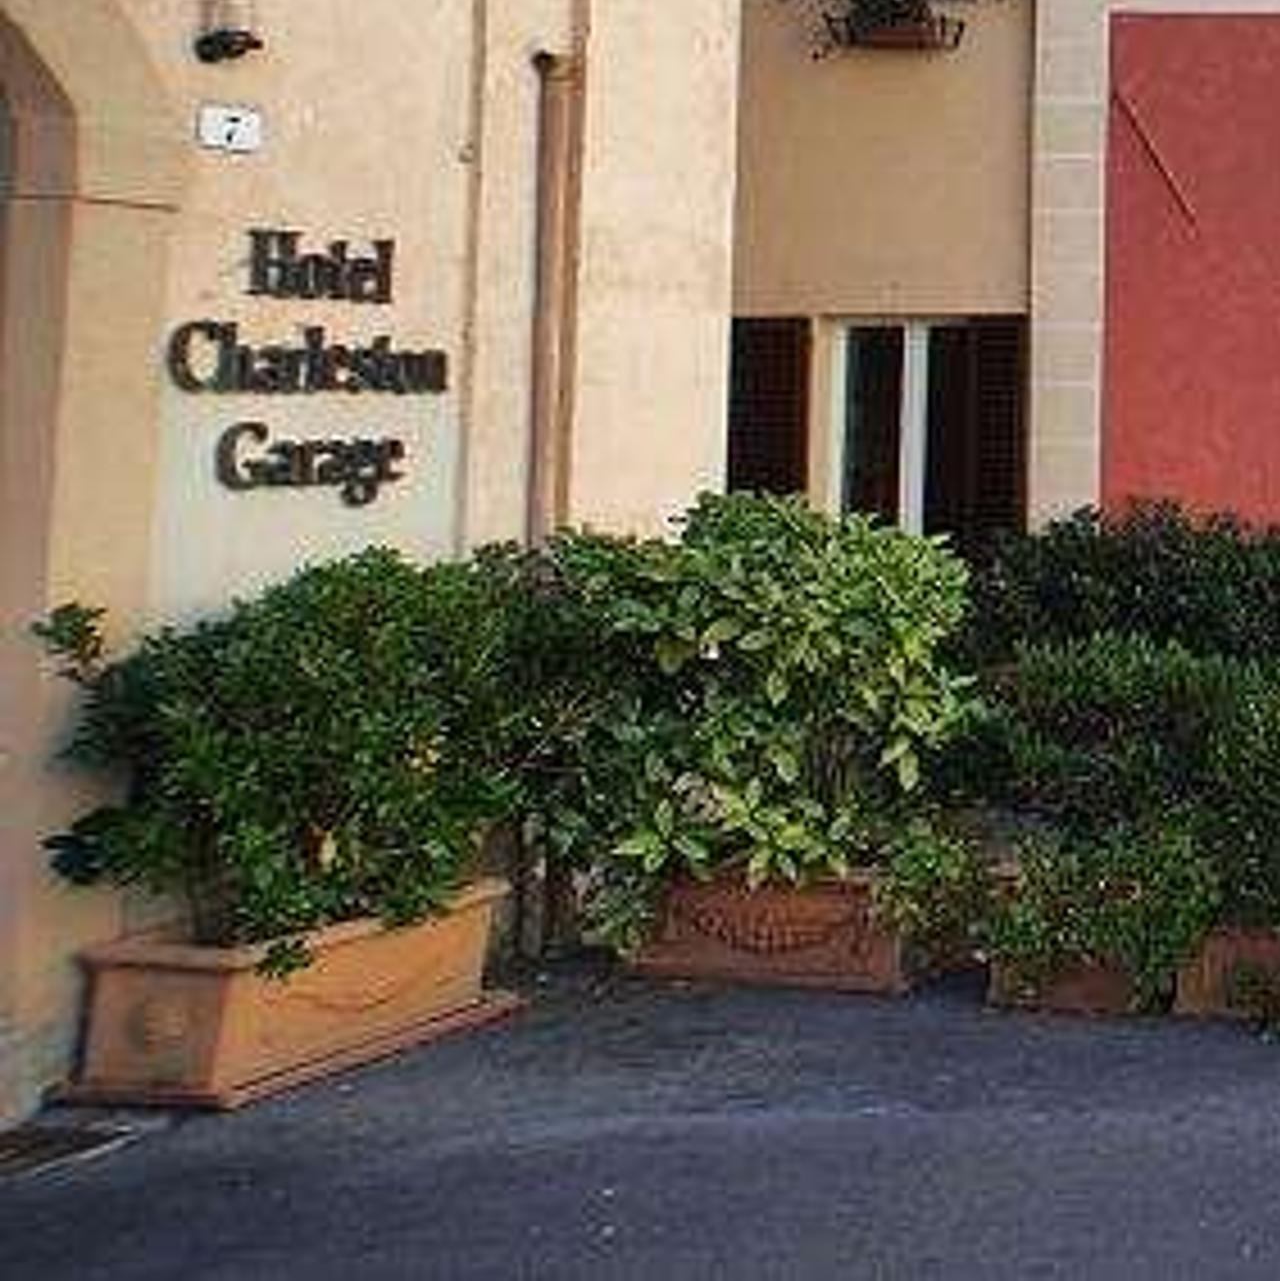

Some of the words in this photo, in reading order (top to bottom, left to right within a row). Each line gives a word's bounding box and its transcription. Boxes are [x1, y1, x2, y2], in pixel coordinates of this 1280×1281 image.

[223, 115, 242, 144] 7
[245, 229, 395, 304] Hotel
[168, 320, 447, 394] Charleston
[215, 421, 404, 507] Garage
